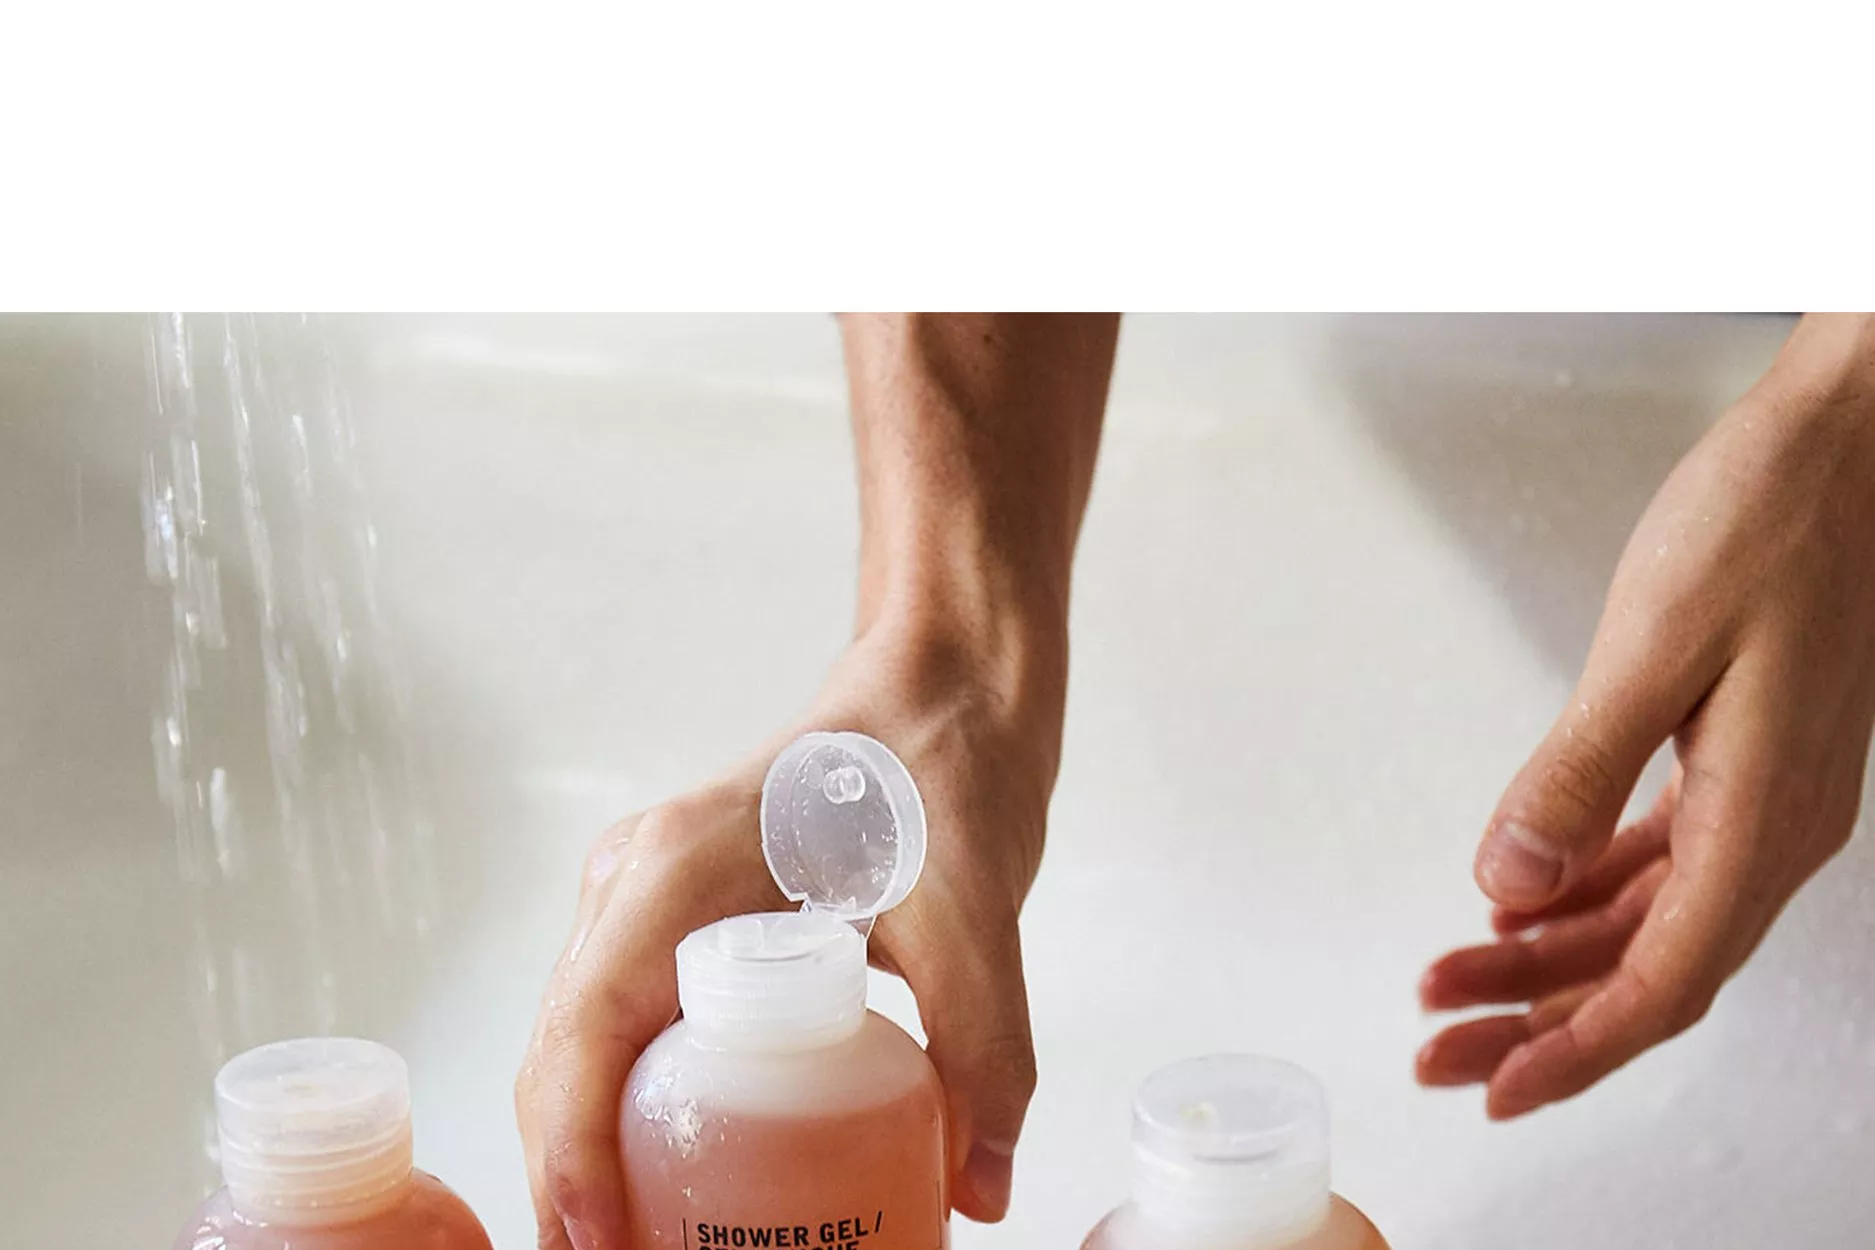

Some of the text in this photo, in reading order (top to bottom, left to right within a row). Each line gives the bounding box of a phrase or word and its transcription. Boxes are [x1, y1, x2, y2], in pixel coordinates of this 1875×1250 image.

[697, 1210, 882, 1248] SHOWER GEL /
